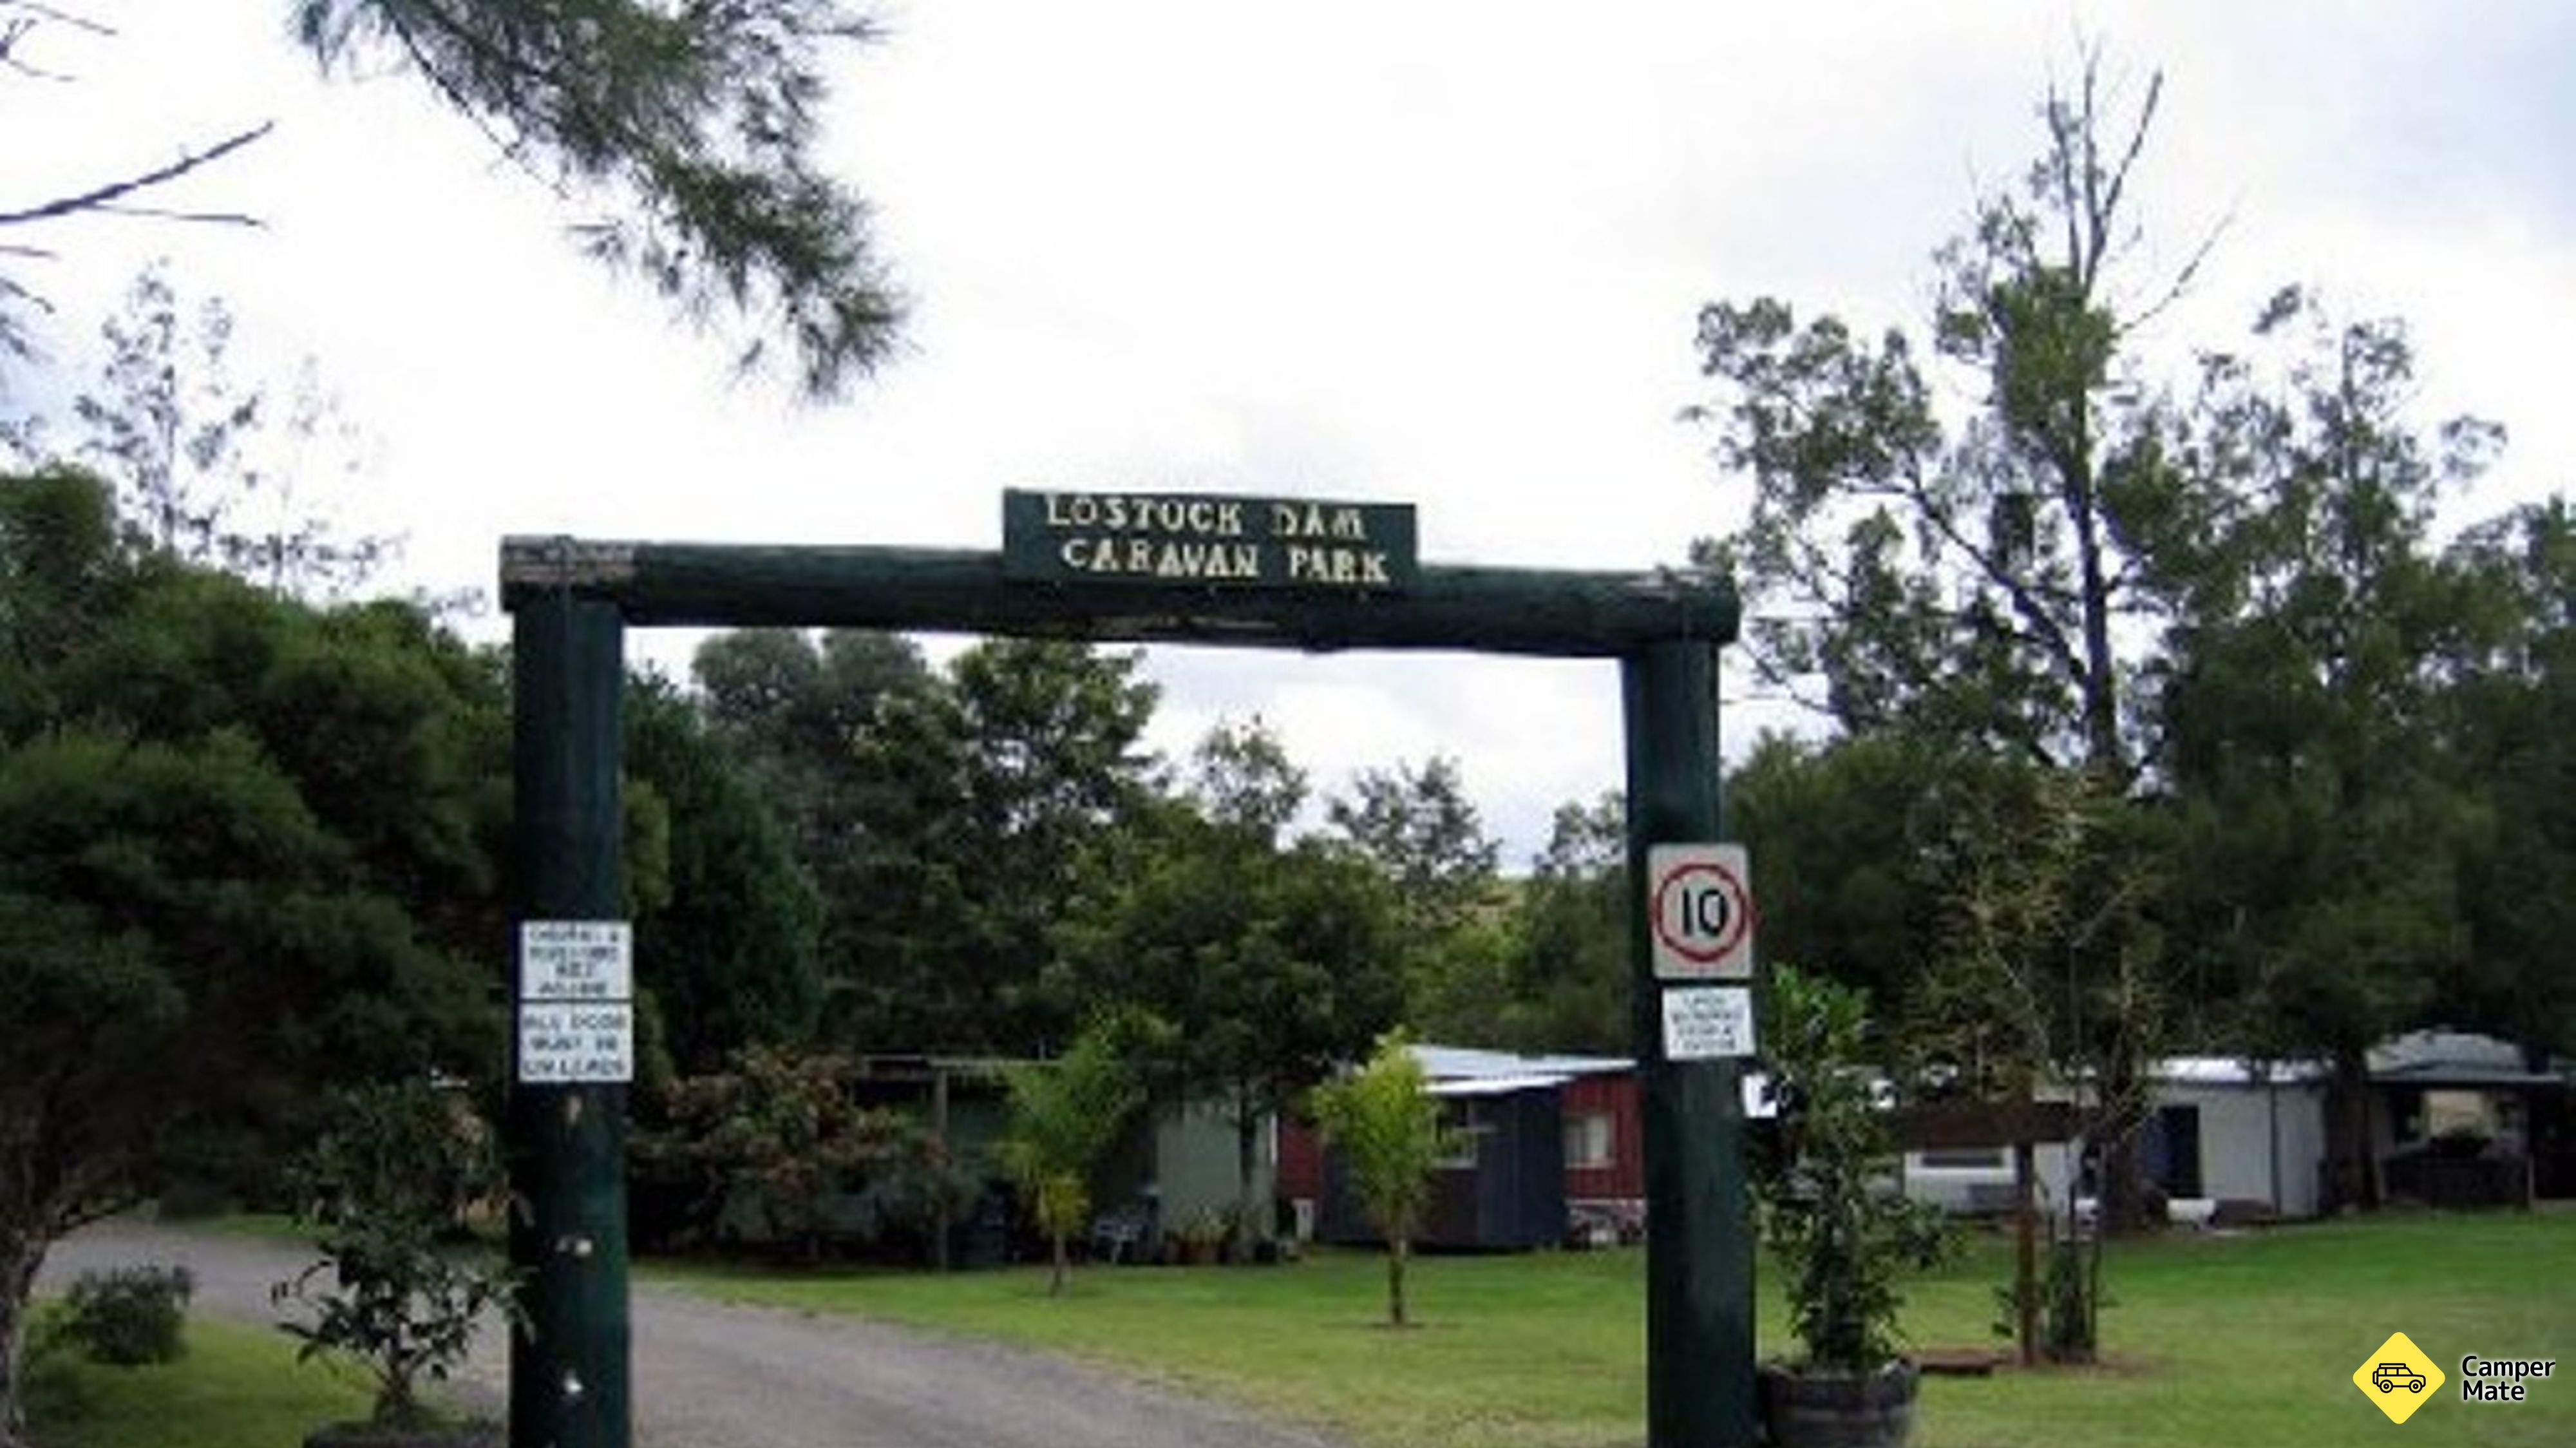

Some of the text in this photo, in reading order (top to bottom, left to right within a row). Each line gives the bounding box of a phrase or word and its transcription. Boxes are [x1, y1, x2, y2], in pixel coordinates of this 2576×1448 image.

[1044, 495, 1365, 539] LOSTOCK DAM
[1062, 538, 1390, 582] CARAVAN PARK
[1682, 888, 1728, 937] 10
